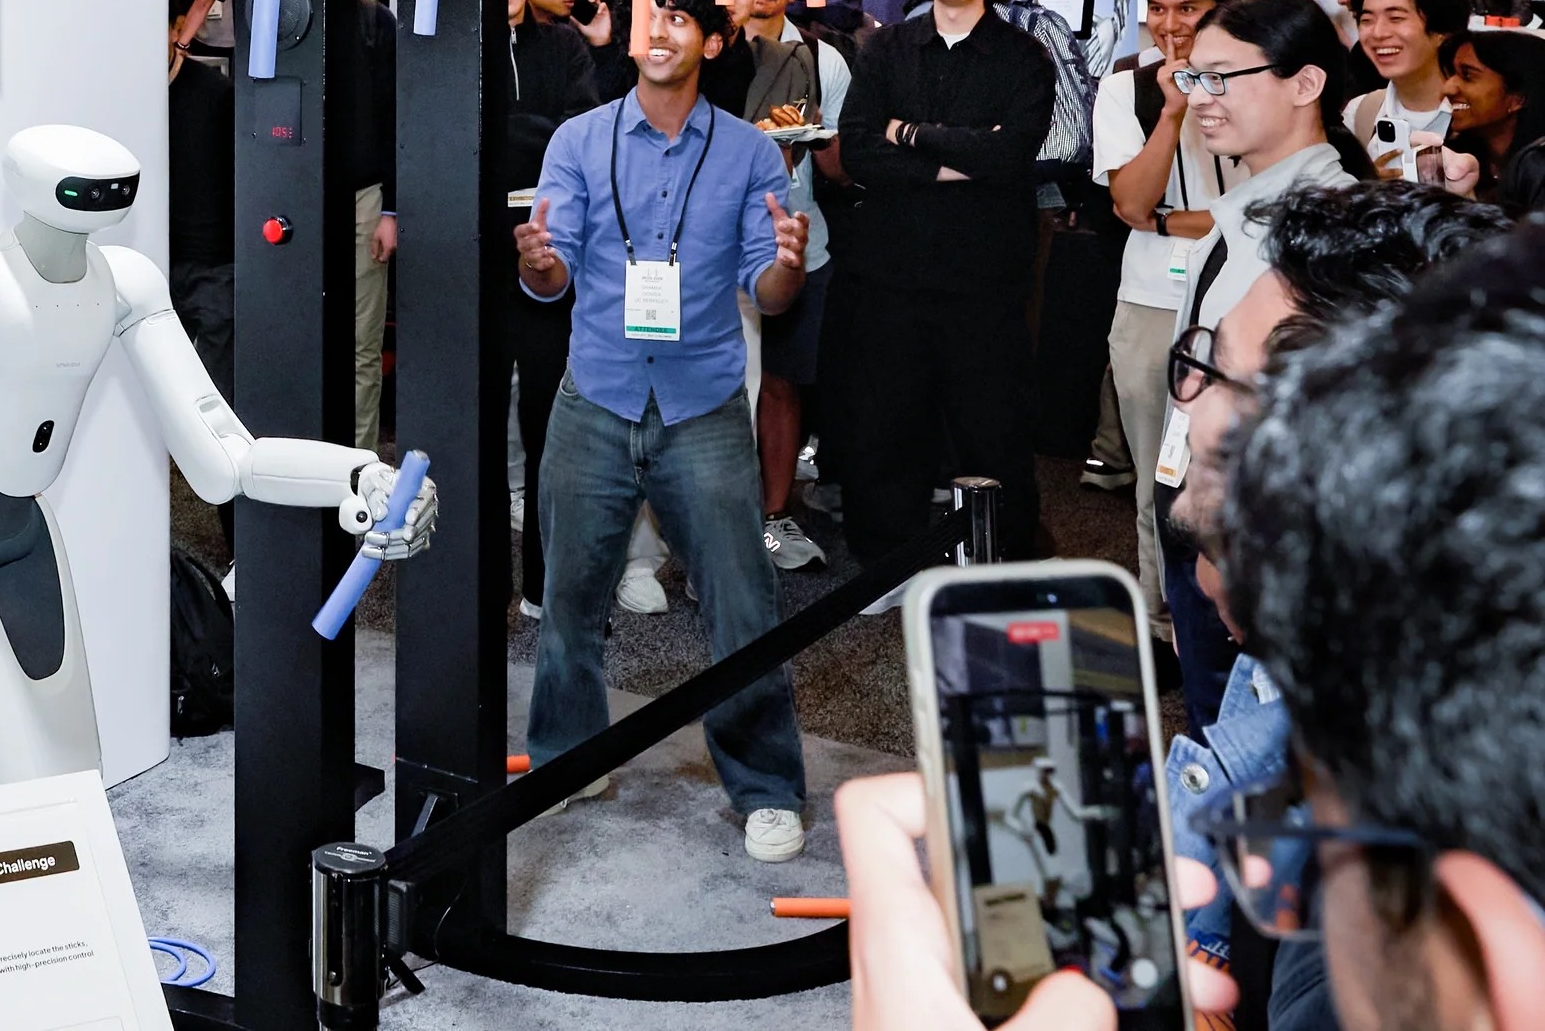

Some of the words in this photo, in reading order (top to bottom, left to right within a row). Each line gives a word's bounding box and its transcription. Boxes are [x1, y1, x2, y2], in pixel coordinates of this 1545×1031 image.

[28, 947, 51, 957] locate
[52, 944, 64, 953] the
[15, 956, 68, 972] high-precision
[68, 949, 94, 961] control
